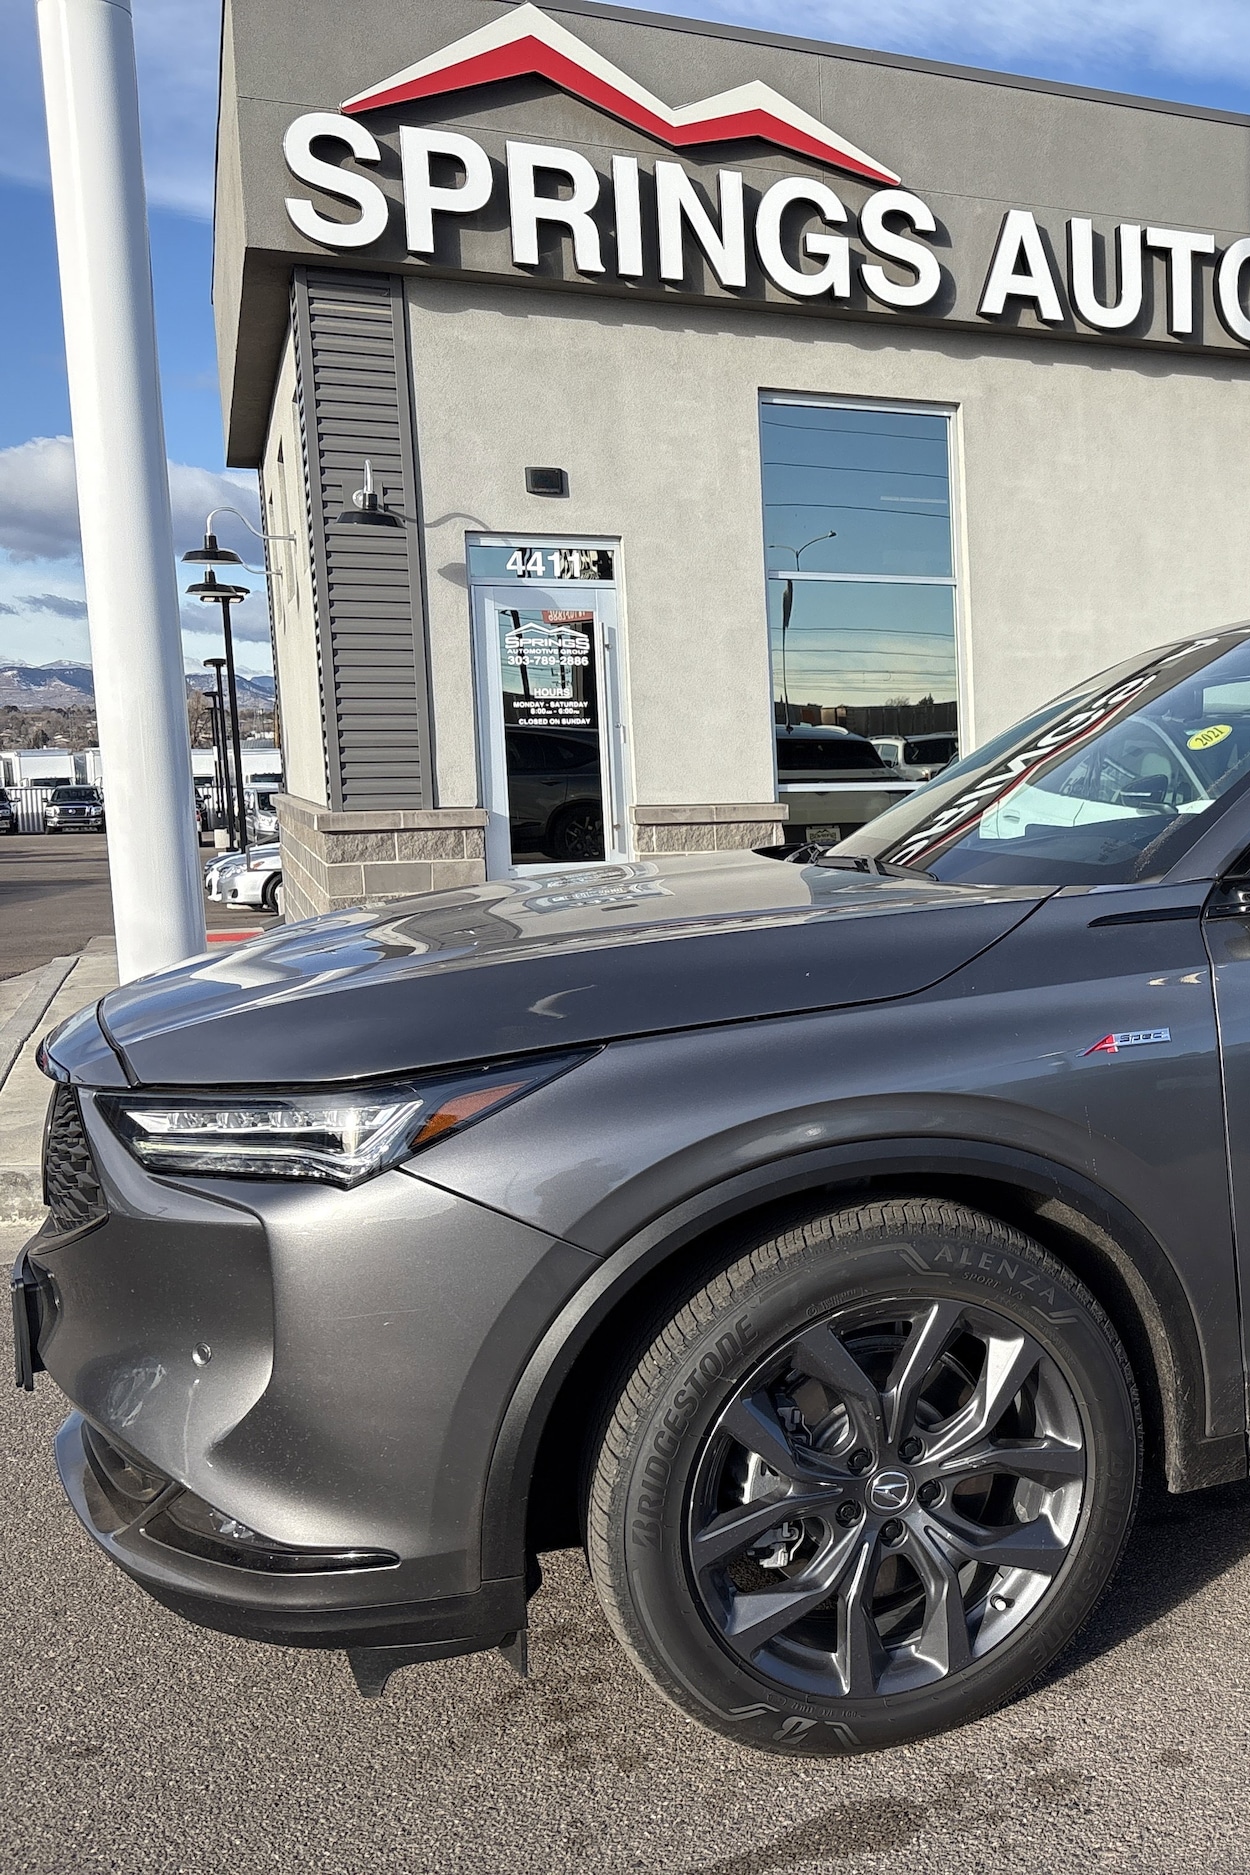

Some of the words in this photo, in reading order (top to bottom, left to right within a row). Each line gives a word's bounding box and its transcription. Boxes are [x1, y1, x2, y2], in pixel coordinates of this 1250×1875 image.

[283, 112, 941, 307] SPRINGS
[506, 550, 580, 578] 4411
[505, 636, 590, 650] SPRINGS
[507, 656, 589, 666] 303-789-2886
[533, 687, 571, 696] HOURS
[1194, 727, 1225, 746] 2021
[934, 1244, 1057, 1305] ALENZA
[962, 1271, 1000, 1289] SPORT
[1004, 1285, 1026, 1301] A/S
[632, 1314, 759, 1552] BRIDGESTONE
